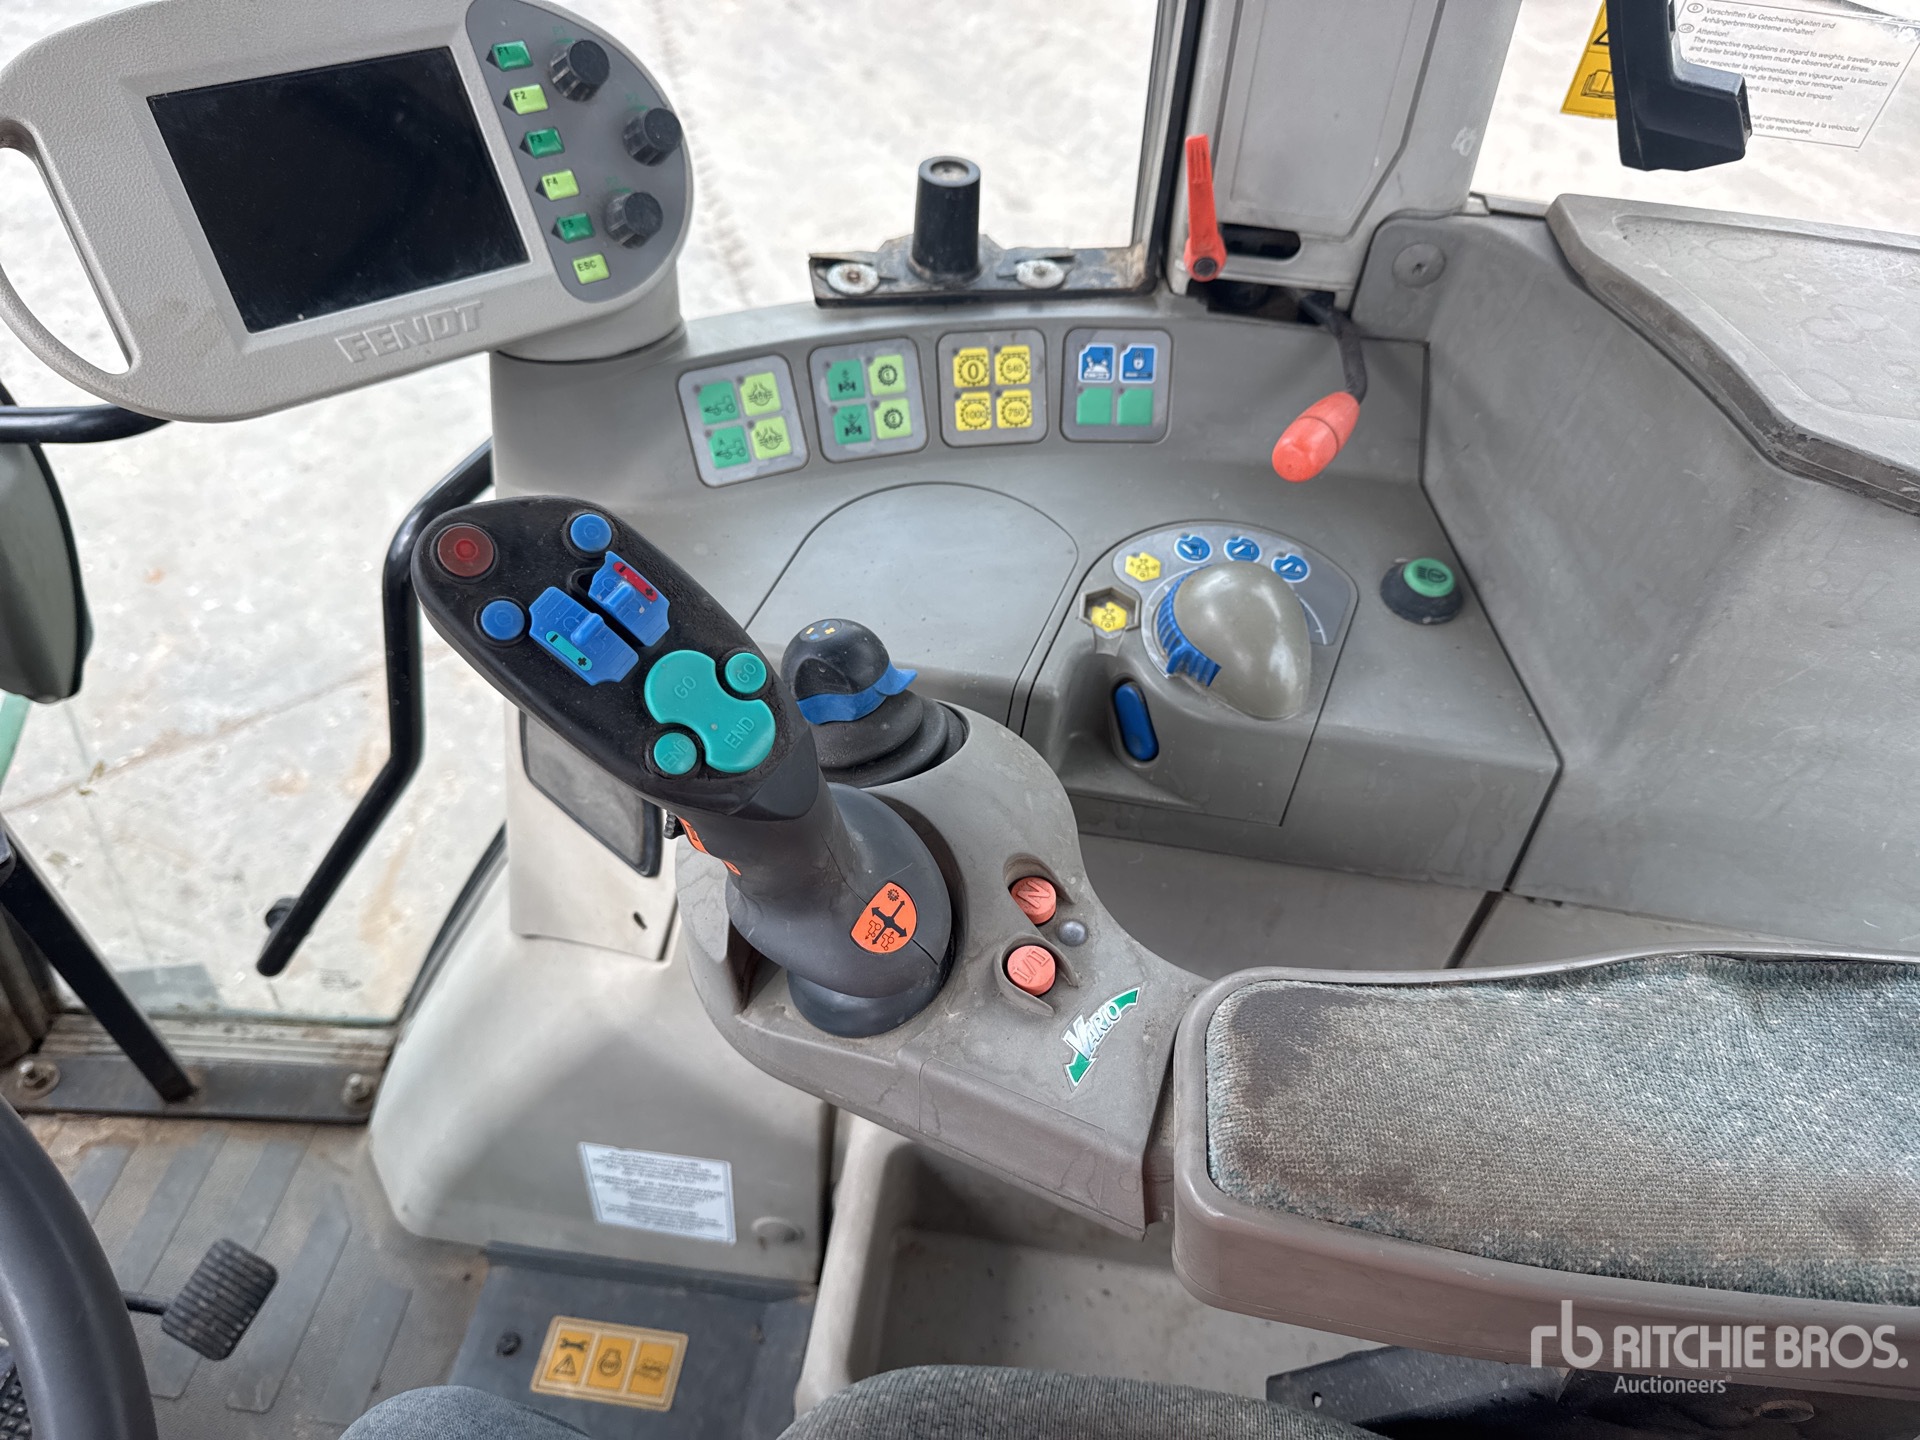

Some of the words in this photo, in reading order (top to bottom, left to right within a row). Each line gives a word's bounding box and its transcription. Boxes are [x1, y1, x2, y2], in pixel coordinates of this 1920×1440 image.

[1701, 16, 1782, 32] Anhängerbremssysteme
[1782, 26, 1816, 35] einhalten!
[1706, 8, 1746, 18] Vorschriften
[1758, 13, 1821, 27] Geschwindigkeiten
[1696, 28, 1730, 37] Attention!
[497, 46, 509, 56] F1
[1702, 46, 1722, 54] trailer
[1722, 49, 1748, 58] braking
[1748, 52, 1773, 61] system
[1773, 56, 1791, 64] must
[1801, 59, 1833, 68] observed
[1706, 38, 1741, 48] respective
[1741, 43, 1778, 53] regulations
[1846, 55, 1877, 66] travelling
[1878, 60, 1900, 68] speed
[1709, 59, 1741, 68] respecter
[1808, 72, 1833, 81] vigueur
[1832, 75, 1850, 83] pour
[1857, 78, 1888, 87] limitation
[514, 90, 526, 101] F2
[1762, 115, 1814, 127] correspondiente
[1828, 123, 1860, 132] velocidad
[530, 134, 543, 145] F3
[546, 177, 558, 187] F4
[561, 220, 574, 230] F5
[577, 260, 597, 273] ESC
[335, 300, 484, 363] FENDT
[967, 362, 979, 379] 0
[1006, 362, 1023, 374] 540
[964, 408, 987, 420] 1000
[1006, 407, 1025, 418] 750
[736, 662, 757, 684] GO
[674, 675, 697, 699] GO
[723, 716, 756, 750] END
[660, 739, 690, 769] END
